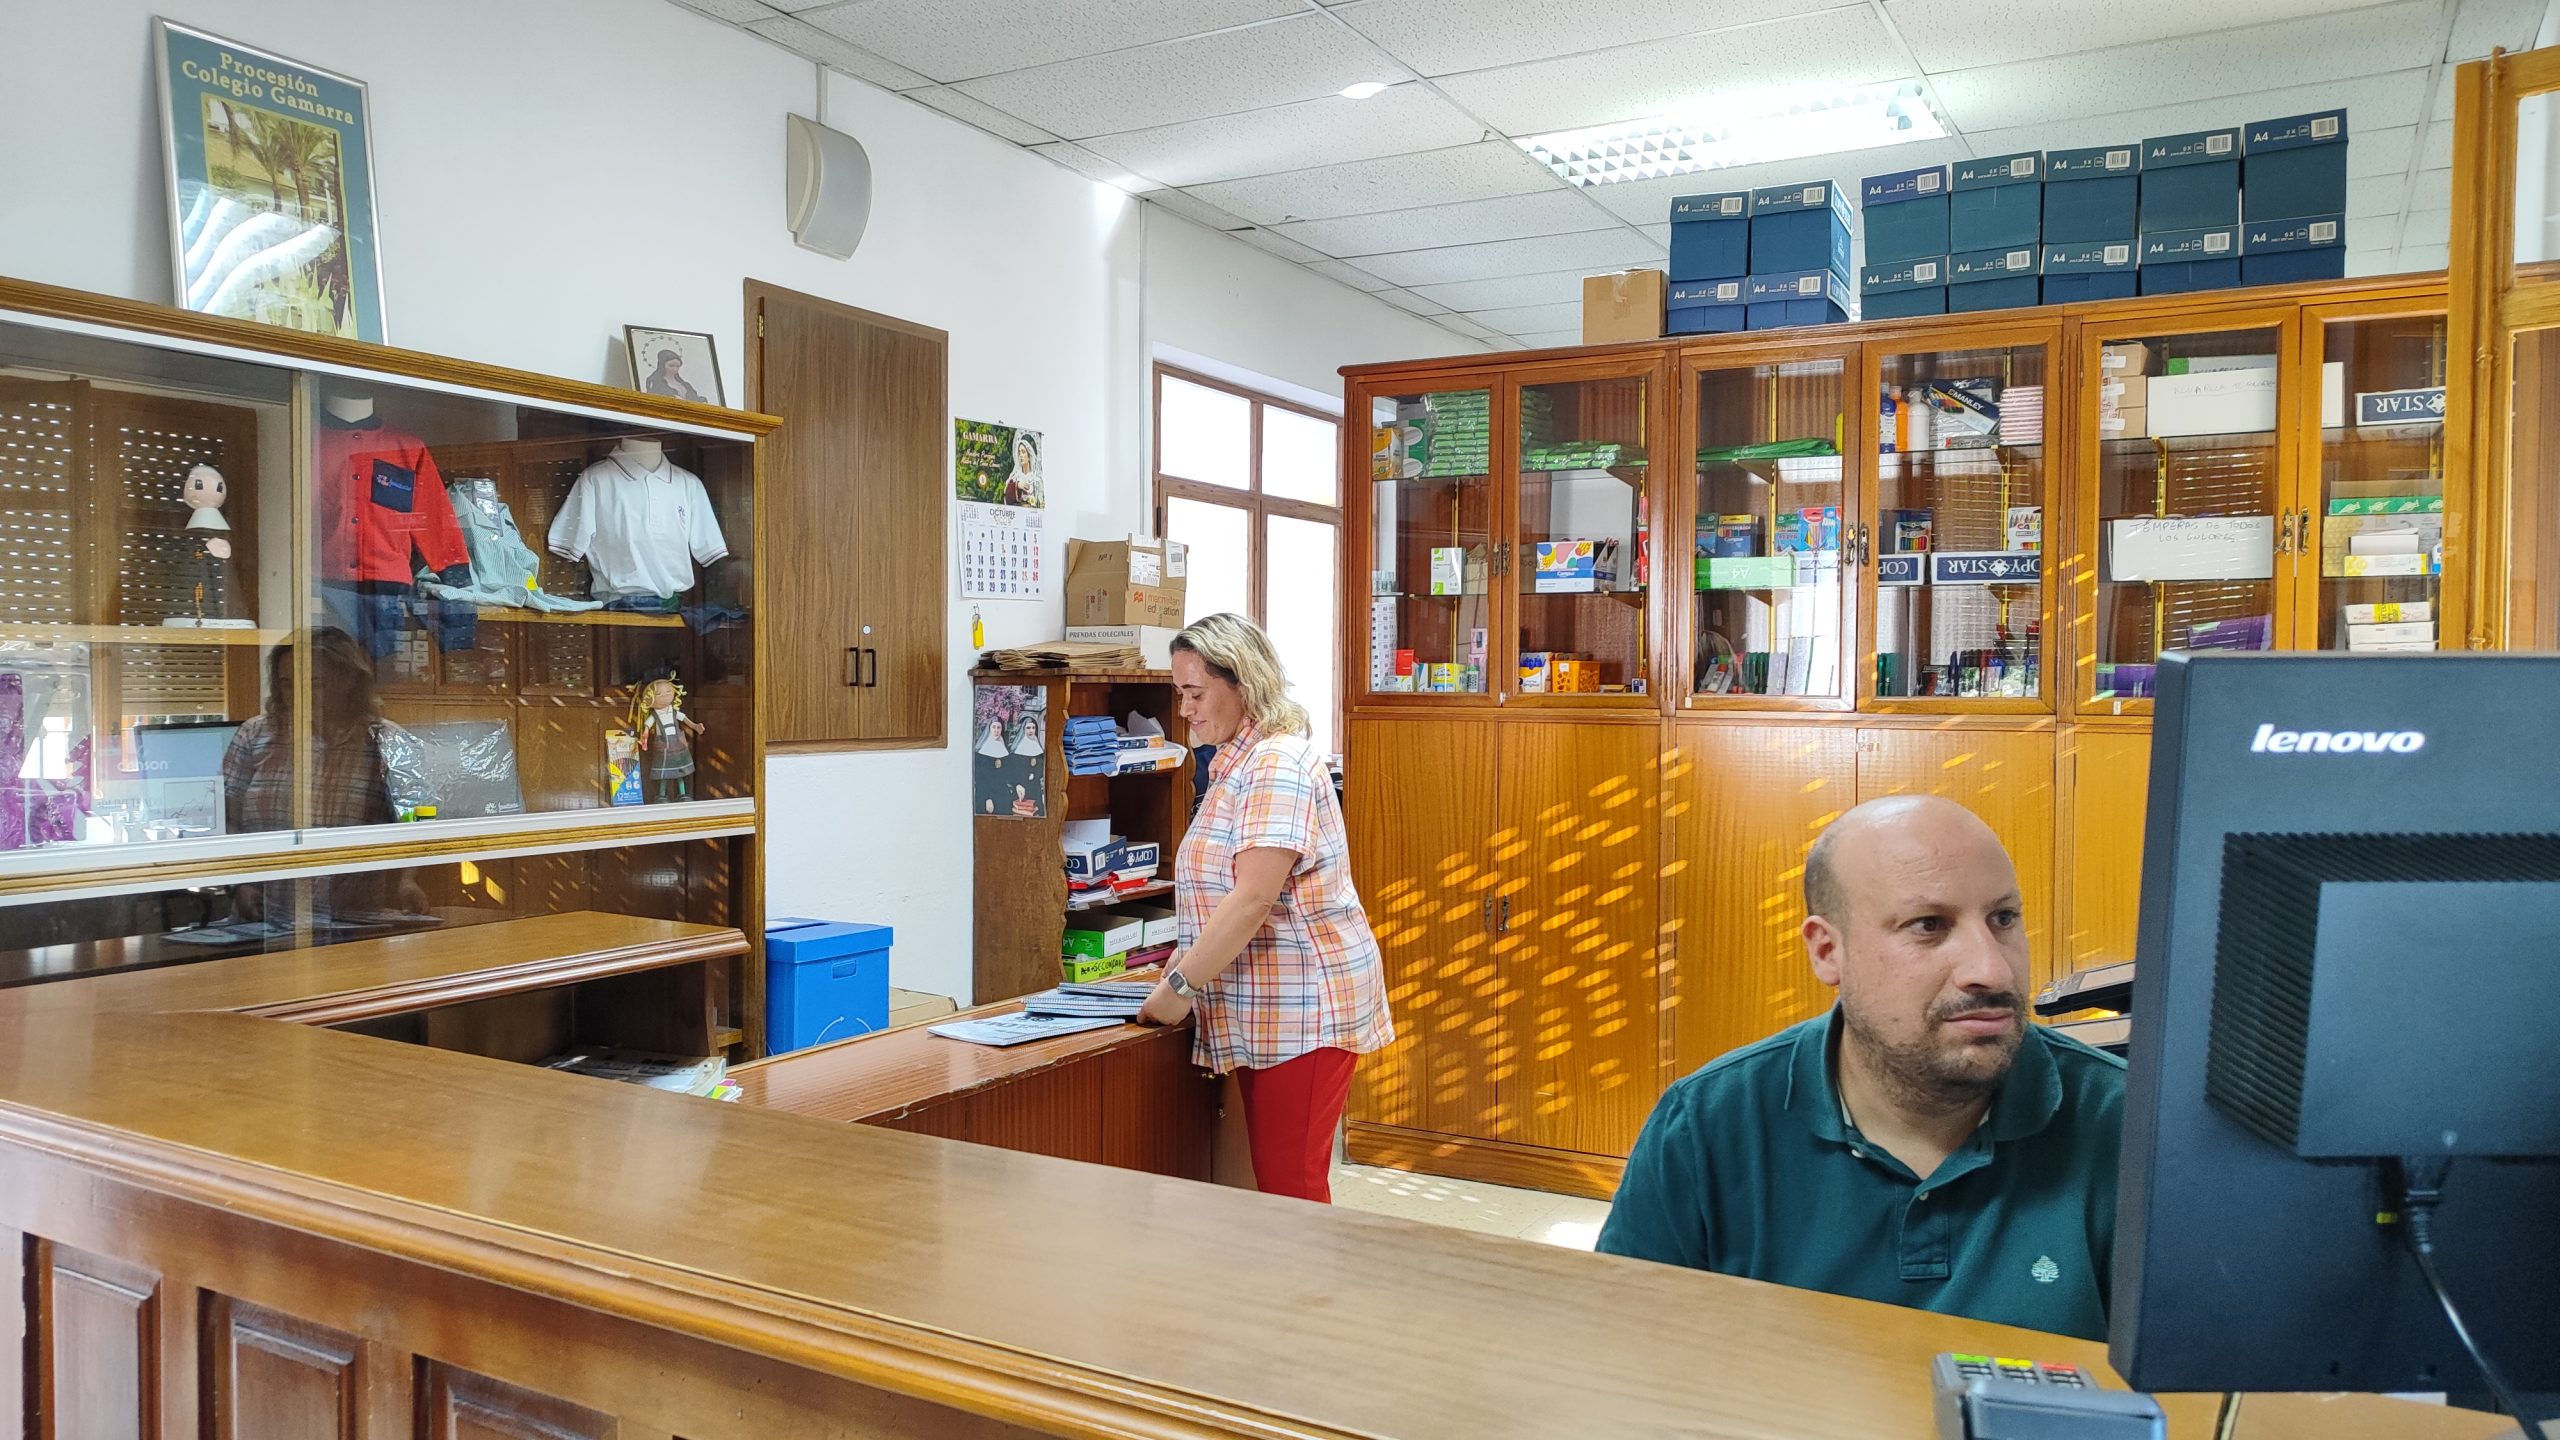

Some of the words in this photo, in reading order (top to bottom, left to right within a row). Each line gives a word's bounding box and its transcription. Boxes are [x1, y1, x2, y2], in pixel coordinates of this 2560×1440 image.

[219, 52, 319, 97] Procesión
[181, 60, 263, 98] Colegio
[270, 86, 354, 125] Gamarra
[2253, 131, 2269, 143] A4
[2152, 147, 2166, 158] A4
[2054, 159, 2068, 170] A4
[1961, 170, 1974, 181] A4
[1869, 185, 1882, 196] A4
[1758, 196, 1770, 206] A4
[1677, 204, 1689, 213] A4
[2251, 232, 2267, 244] A4
[2150, 243, 2164, 254] A4
[2052, 253, 2066, 263] A4
[1957, 262, 1971, 273] A4
[1867, 274, 1880, 285] A4
[1754, 284, 1766, 294] A4
[1674, 290, 1686, 300] A4
[2375, 395, 2424, 413] STAR
[963, 431, 998, 444] GAMARRA
[989, 508, 1016, 518] OCTUBRE
[2226, 521, 2262, 530] TODOS
[991, 530, 993, 539] 1
[1001, 530, 1004, 540] 2
[1013, 532, 1015, 541] 3
[1034, 534, 1037, 544] 5
[967, 541, 970, 551] 6
[979, 542, 982, 551] 7
[1012, 544, 1017, 554] 10
[1023, 546, 1027, 555] 11
[1034, 546, 1038, 556] 12
[966, 555, 971, 564] 13
[978, 555, 983, 565] 14
[990, 556, 995, 565] 15
[1001, 557, 1006, 566] 16
[1012, 558, 1016, 567] 17
[1023, 558, 1028, 568] 18
[1948, 559, 1988, 574] STAR
[966, 568, 972, 577] 20
[989, 569, 995, 578] 22
[1011, 571, 1016, 580] 24
[1731, 566, 1752, 579] A4
[978, 582, 984, 591] 28
[990, 582, 995, 592] 29
[1000, 583, 1006, 592] 30
[1012, 583, 1016, 593] 31
[1147, 605, 1180, 616] edation
[1069, 631, 1097, 639] PRENDAS
[1097, 630, 1134, 638] COLEGIALES
[2250, 723, 2426, 753] lenovo
[1135, 849, 1153, 863] COPY
